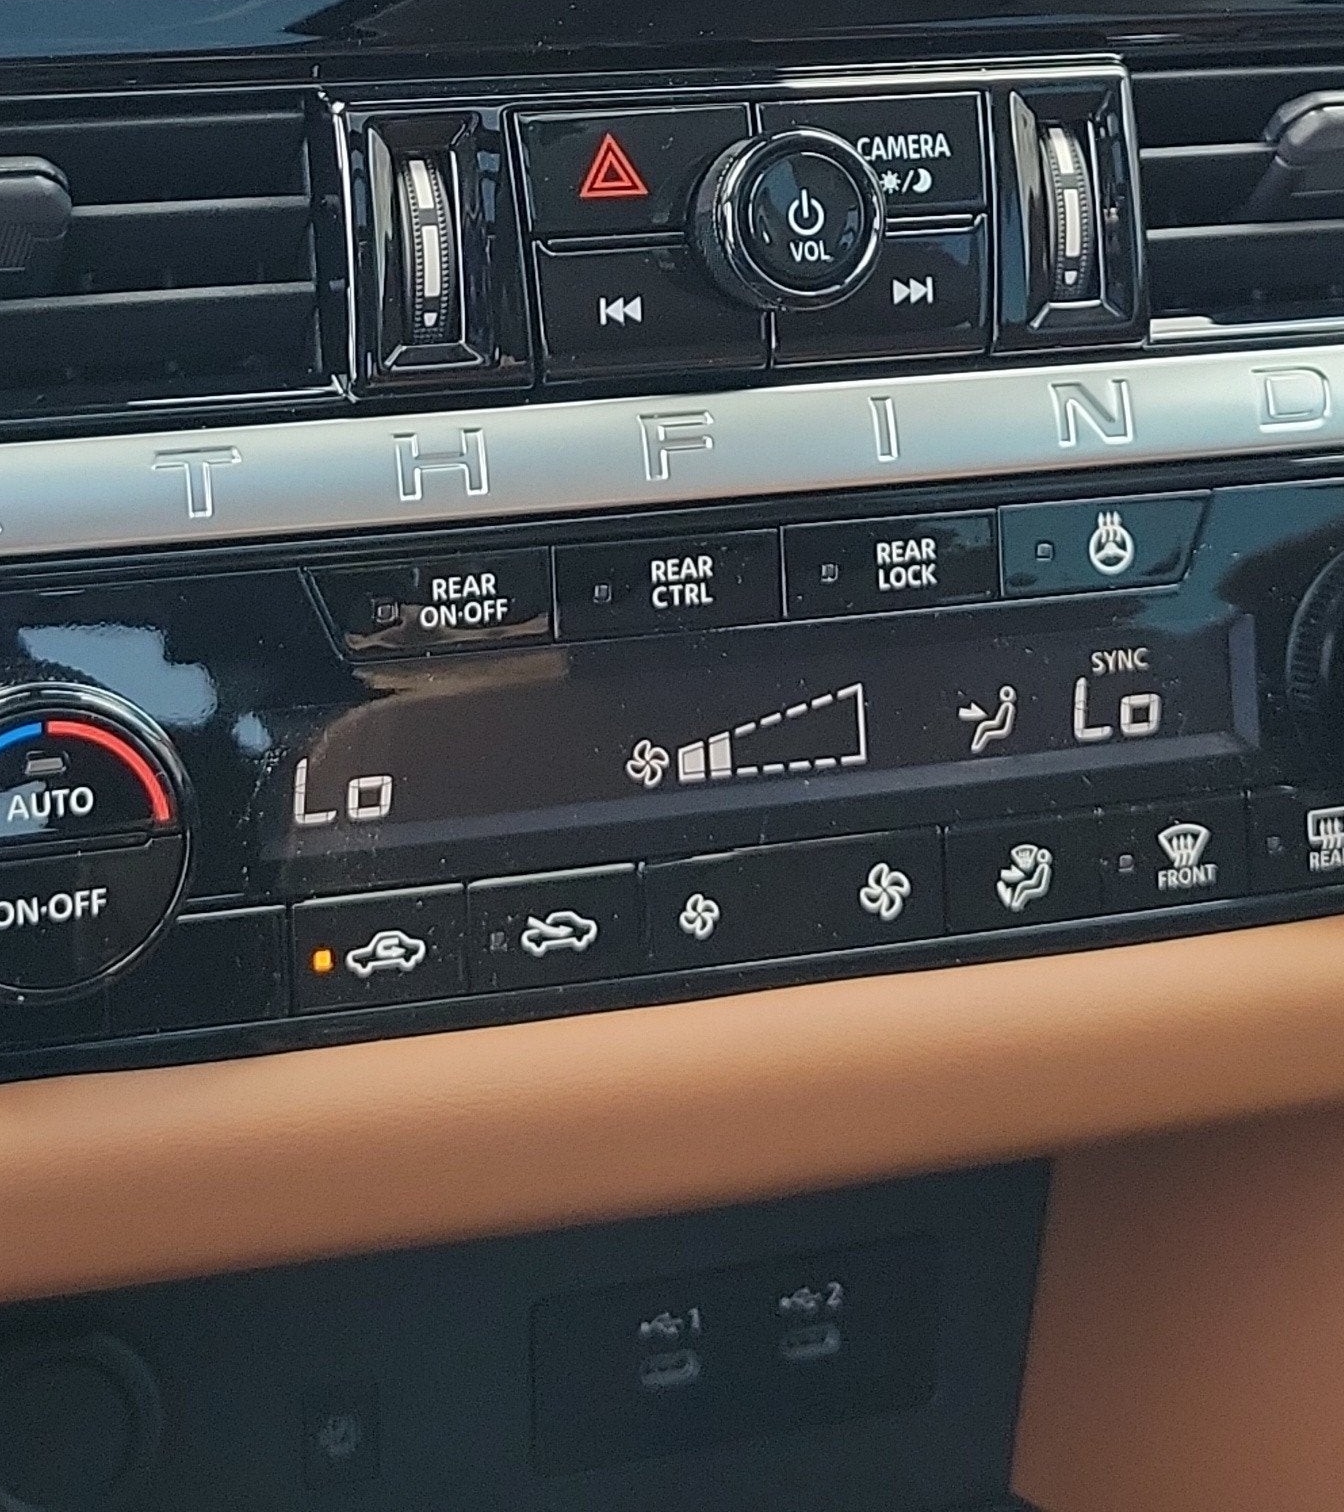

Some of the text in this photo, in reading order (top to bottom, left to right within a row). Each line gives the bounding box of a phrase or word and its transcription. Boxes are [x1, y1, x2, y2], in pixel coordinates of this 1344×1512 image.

[856, 132, 951, 162] CAMERA
[789, 239, 832, 262] VOL
[876, 537, 937, 566] REAR
[650, 555, 714, 584] REAR
[878, 563, 937, 592] LOCK
[431, 572, 497, 602] REAR
[652, 582, 714, 609] CTRL
[1091, 647, 1150, 675] SYNC
[8, 786, 94, 822] AUTO
[1158, 864, 1218, 890] FRONT
